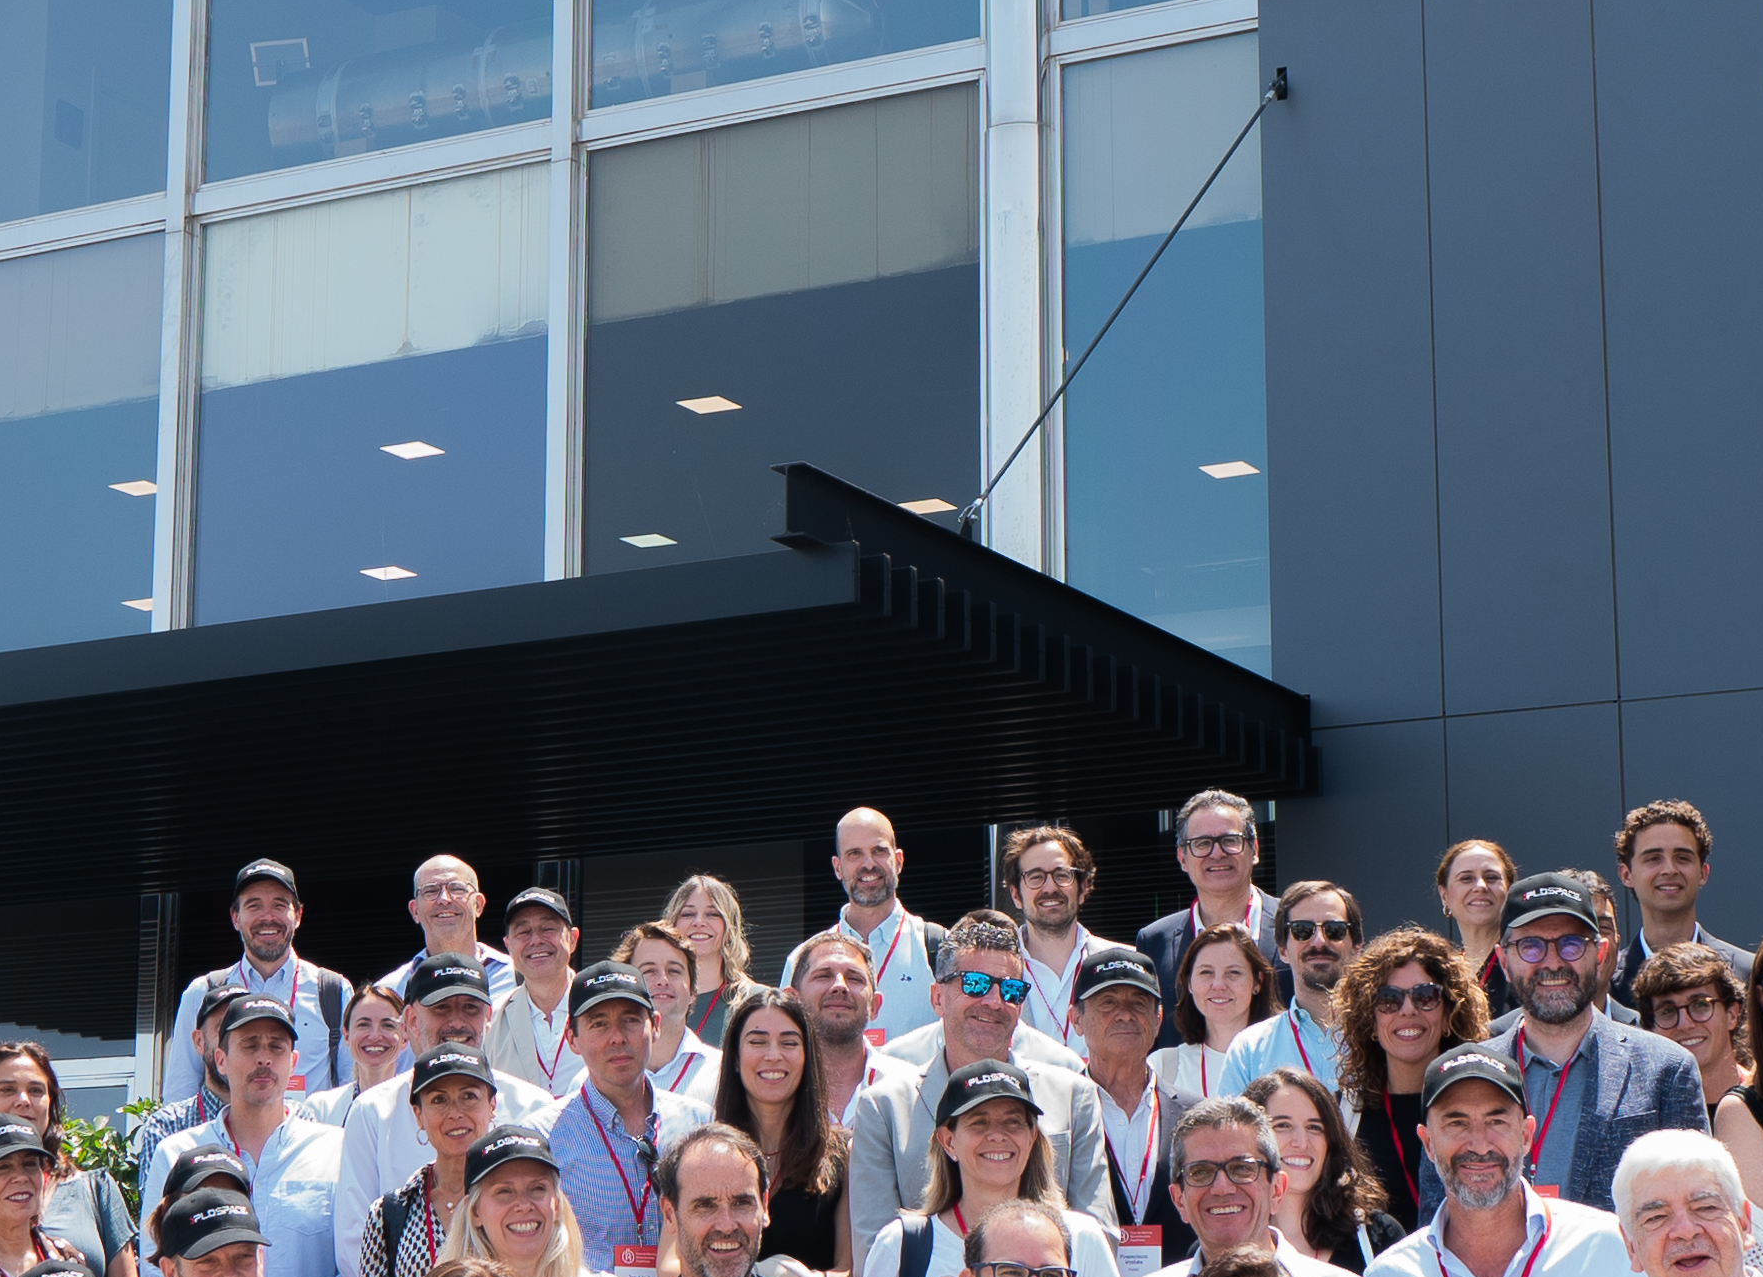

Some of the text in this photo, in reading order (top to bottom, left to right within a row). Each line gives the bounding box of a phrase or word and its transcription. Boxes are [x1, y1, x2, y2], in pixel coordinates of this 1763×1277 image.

[1525, 886, 1582, 902] PLDSPACE
[434, 966, 482, 979] PLDSPACE
[1096, 960, 1146, 974] PLDSPACE
[585, 972, 638, 987] PLDSPACE
[192, 1205, 249, 1224] PLDSPACE
